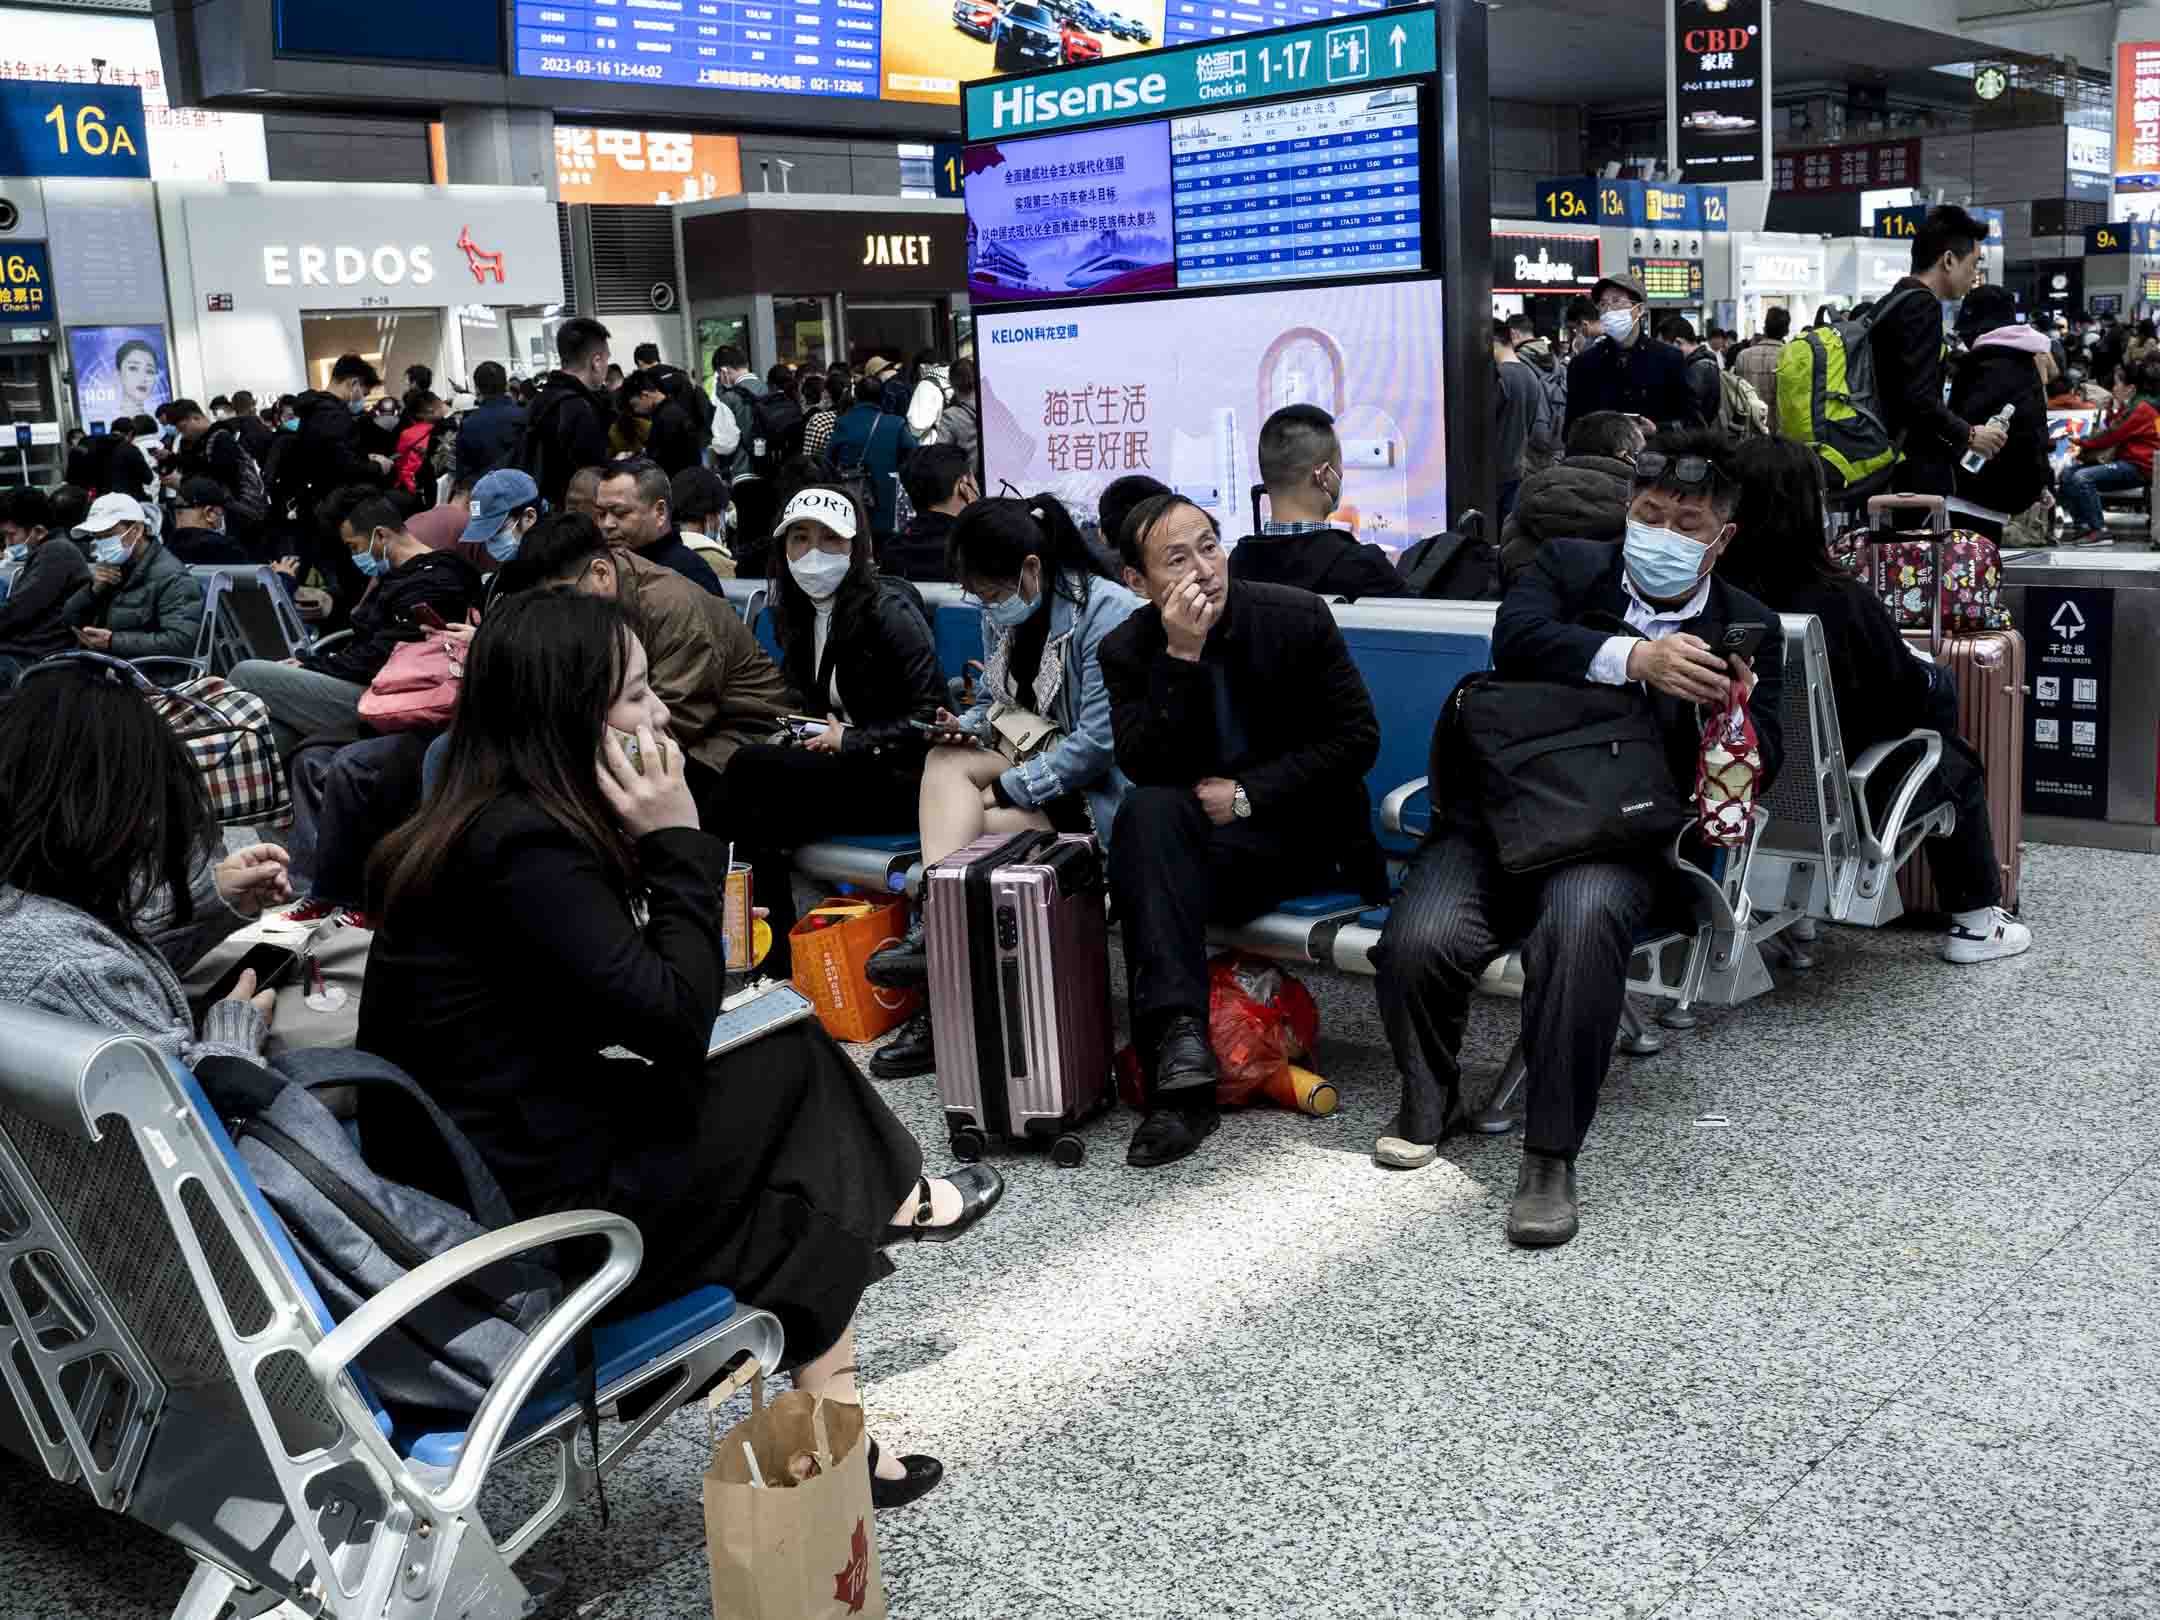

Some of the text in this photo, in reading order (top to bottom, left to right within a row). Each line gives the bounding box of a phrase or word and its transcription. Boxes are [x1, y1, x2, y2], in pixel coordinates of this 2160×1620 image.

[1684, 27, 1749, 54] CBD
[541, 57, 663, 79] 2023-03-16 12:44:02
[1257, 39, 1312, 84] 1-17
[1700, 52, 1734, 71] 家居
[992, 70, 1168, 128] Hisense
[1199, 82, 1246, 100] Check in
[44, 104, 137, 156] 16A
[944, 157, 966, 193] 1
[1545, 191, 1587, 217] 13A
[1600, 189, 1624, 216] 13A
[1704, 196, 1726, 222] 12A
[1882, 215, 1917, 236] 11A
[2096, 229, 2118, 249] 9A
[863, 234, 932, 266] JAKET
[263, 245, 434, 286] ERDOS
[3, 302, 41, 313] Check in
[1044, 384, 1146, 427] 猫式生活
[1047, 431, 1151, 472] 轻音好眠
[2048, 643, 2085, 656] 干垃圾
